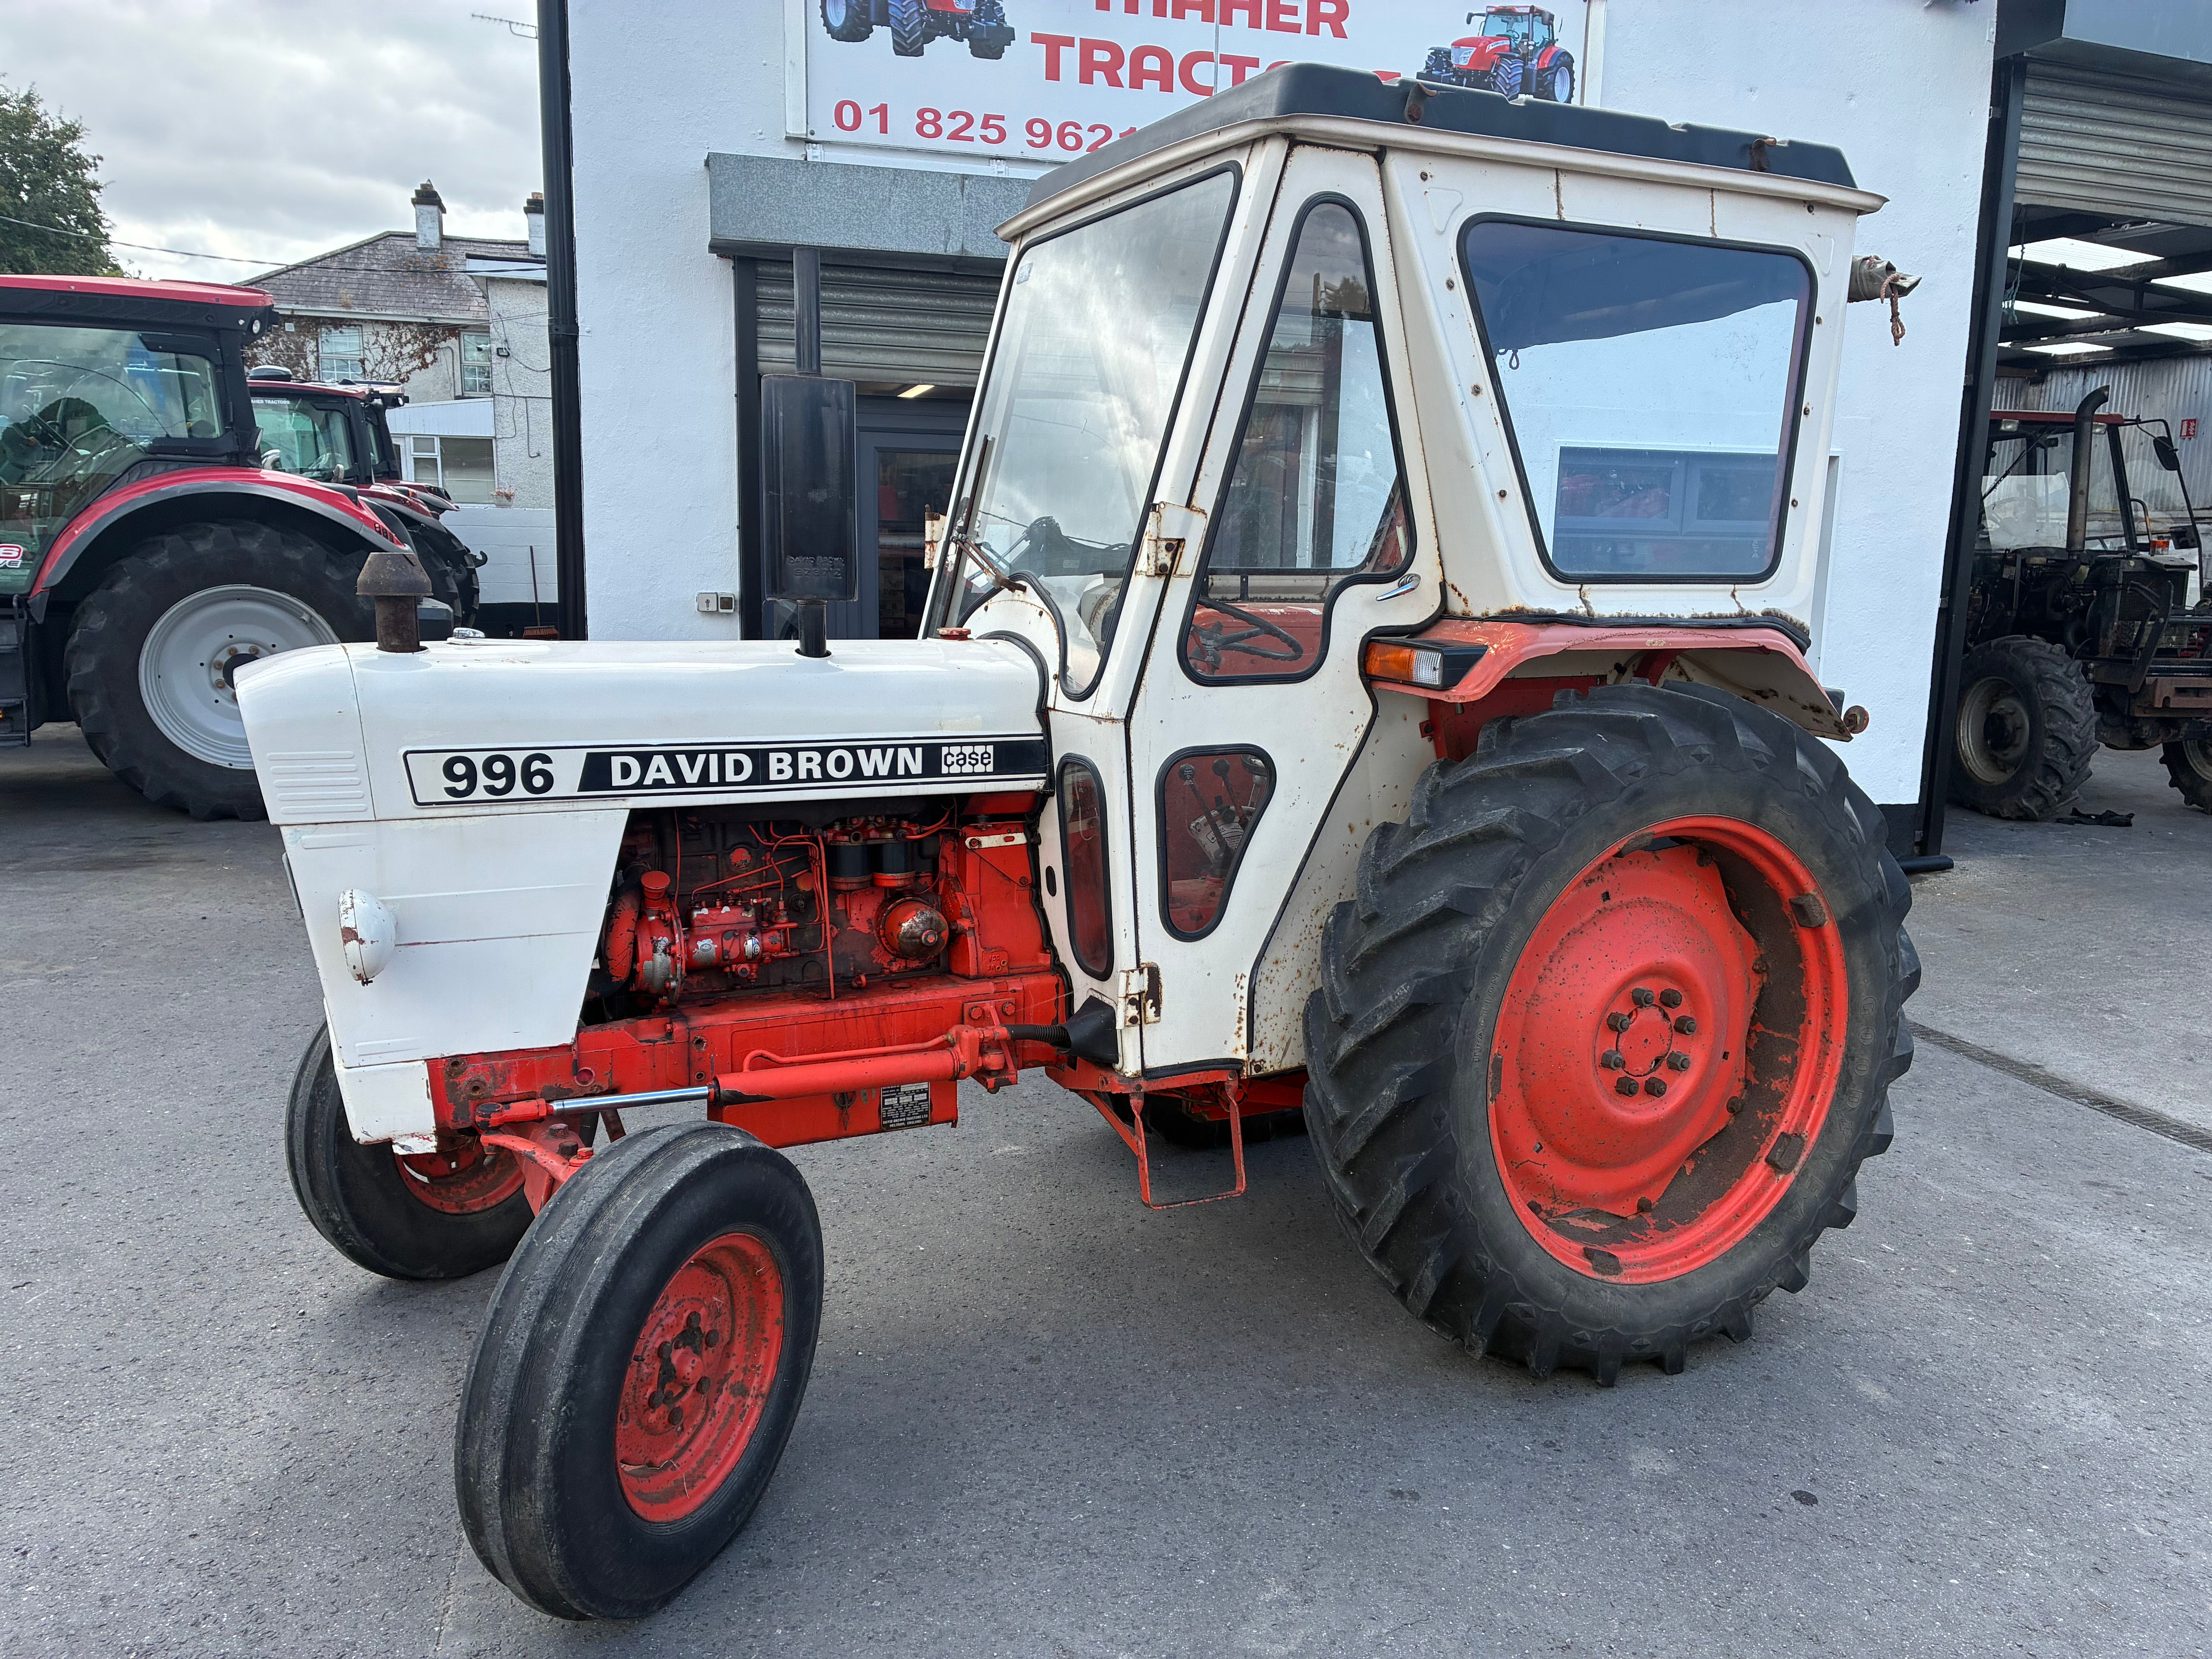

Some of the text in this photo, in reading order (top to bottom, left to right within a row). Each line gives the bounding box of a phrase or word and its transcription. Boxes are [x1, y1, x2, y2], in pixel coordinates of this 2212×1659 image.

[1031, 33, 1401, 96] TRACT
[835, 100, 888, 134] 01
[915, 108, 1007, 144] 825
[442, 753, 555, 798] 996
[611, 753, 753, 787] DAVID
[769, 747, 922, 781] BROWN
[1768, 996, 1876, 1249] GOODYEAR
